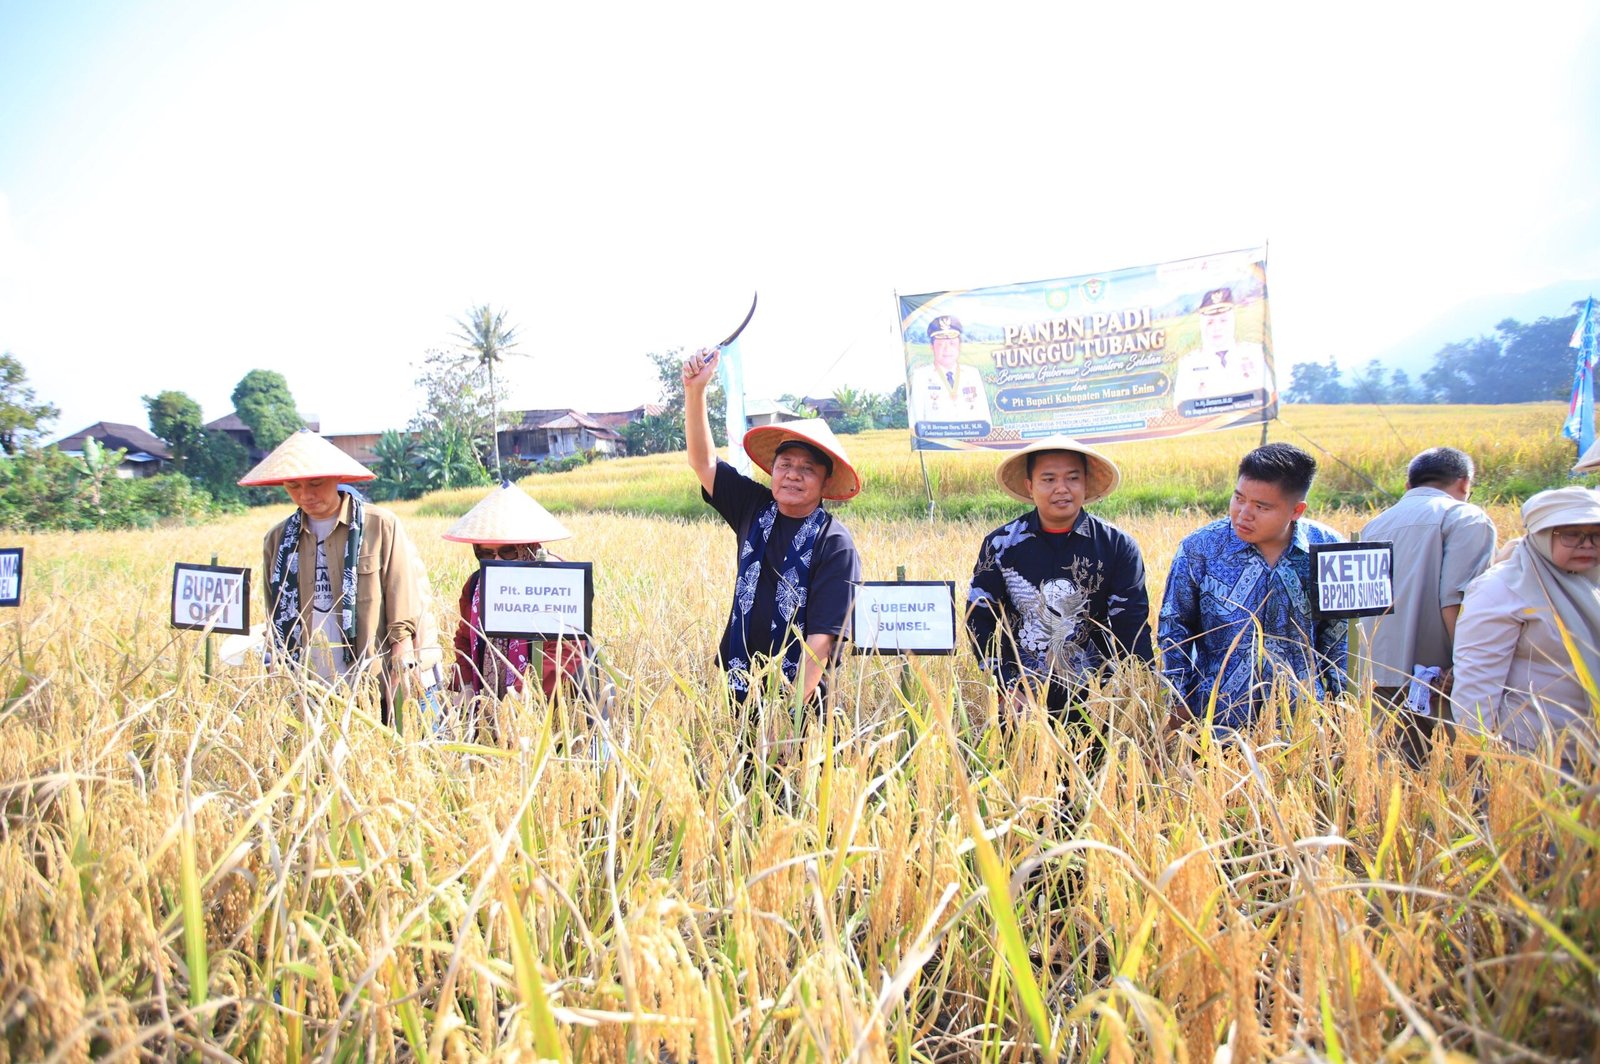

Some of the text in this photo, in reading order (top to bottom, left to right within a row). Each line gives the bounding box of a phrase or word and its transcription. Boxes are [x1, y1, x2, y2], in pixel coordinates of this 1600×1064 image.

[1003, 307, 1152, 346] PANEN PADI
[992, 329, 1166, 367] TUNGGU TUBANG
[996, 354, 1161, 385] Bersama Gubernur Sumatera Selatan
[1012, 385, 1155, 408] Plt Bupati Kabupaten Muara Enim
[1071, 381, 1087, 392] dan
[1320, 553, 1390, 582] KETUA
[182, 575, 240, 604] BUPATI
[500, 586, 571, 596] Plt. BUPATI
[1322, 581, 1389, 609] BP2HD SUMSEL
[189, 602, 229, 624] OKI
[493, 602, 577, 614] MUARA ENIM
[871, 602, 936, 613] GUBENUR
[878, 621, 931, 632] SUMSEL
